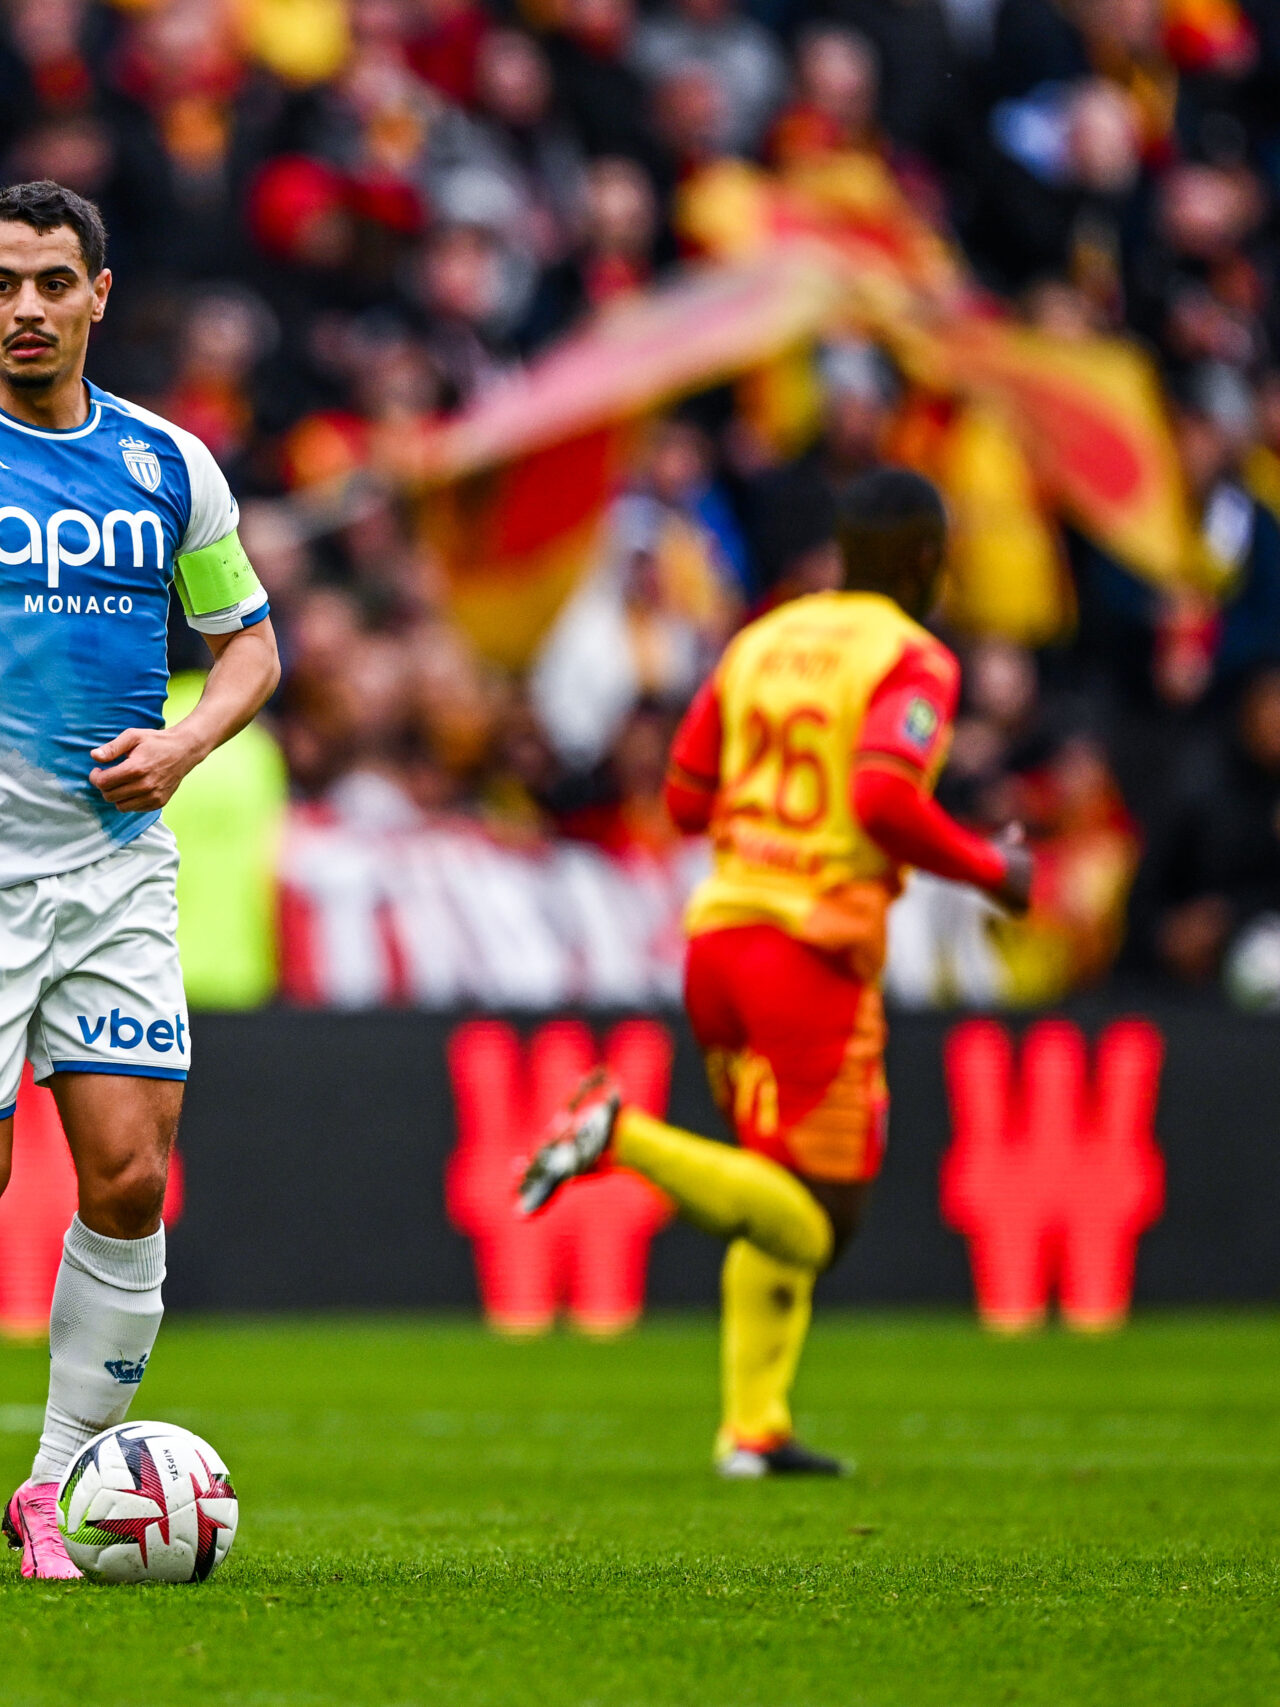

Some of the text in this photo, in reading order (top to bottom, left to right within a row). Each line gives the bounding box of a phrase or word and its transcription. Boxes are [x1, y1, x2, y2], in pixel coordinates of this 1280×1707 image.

[23, 595, 133, 614] MONACO
[716, 701, 831, 831] 26
[76, 1008, 186, 1055] vbet
[163, 1448, 179, 1481] KIPSTA
